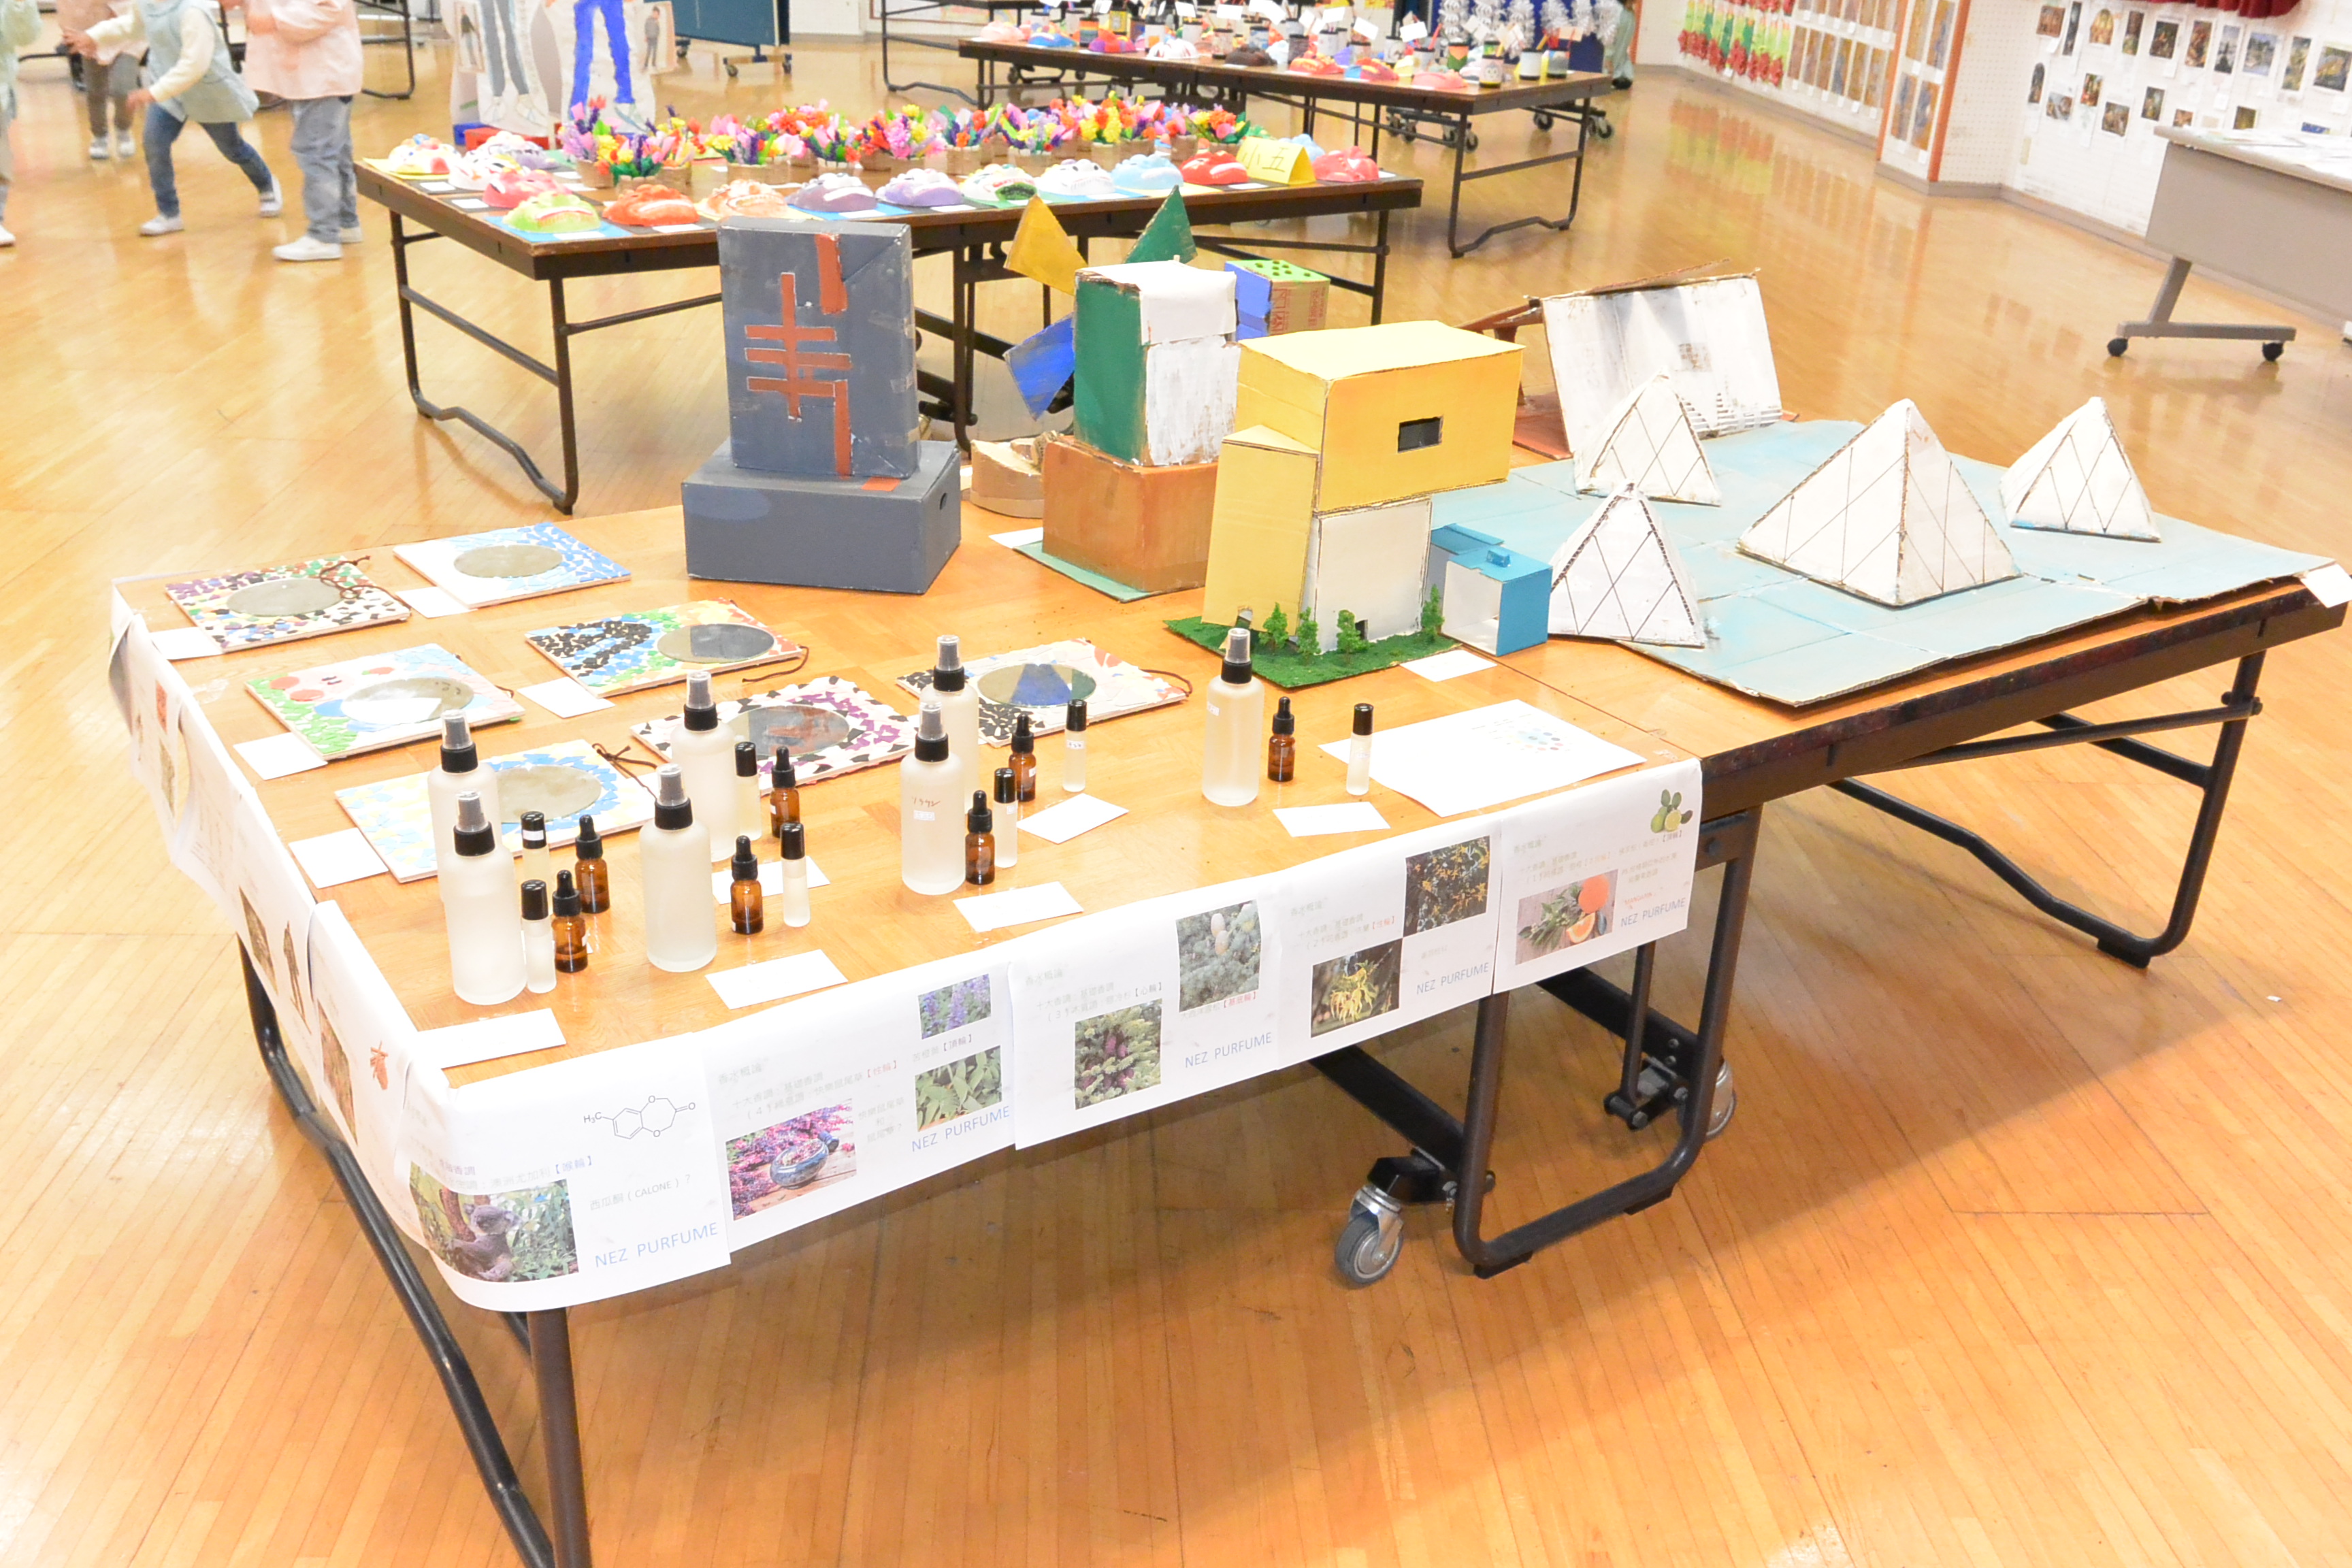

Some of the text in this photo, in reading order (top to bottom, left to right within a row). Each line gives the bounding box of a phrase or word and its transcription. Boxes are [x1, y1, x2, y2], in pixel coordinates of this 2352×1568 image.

[1241, 144, 1288, 173] 小五
[1620, 897, 1686, 928] NEZ PURFUME
[1416, 962, 1489, 995] NEZ PURFUME
[1186, 1032, 1272, 1068] NEZ PURFUME
[911, 1105, 1010, 1152] NEZ PURFUME
[595, 1222, 719, 1267] NEZ PURFUME
